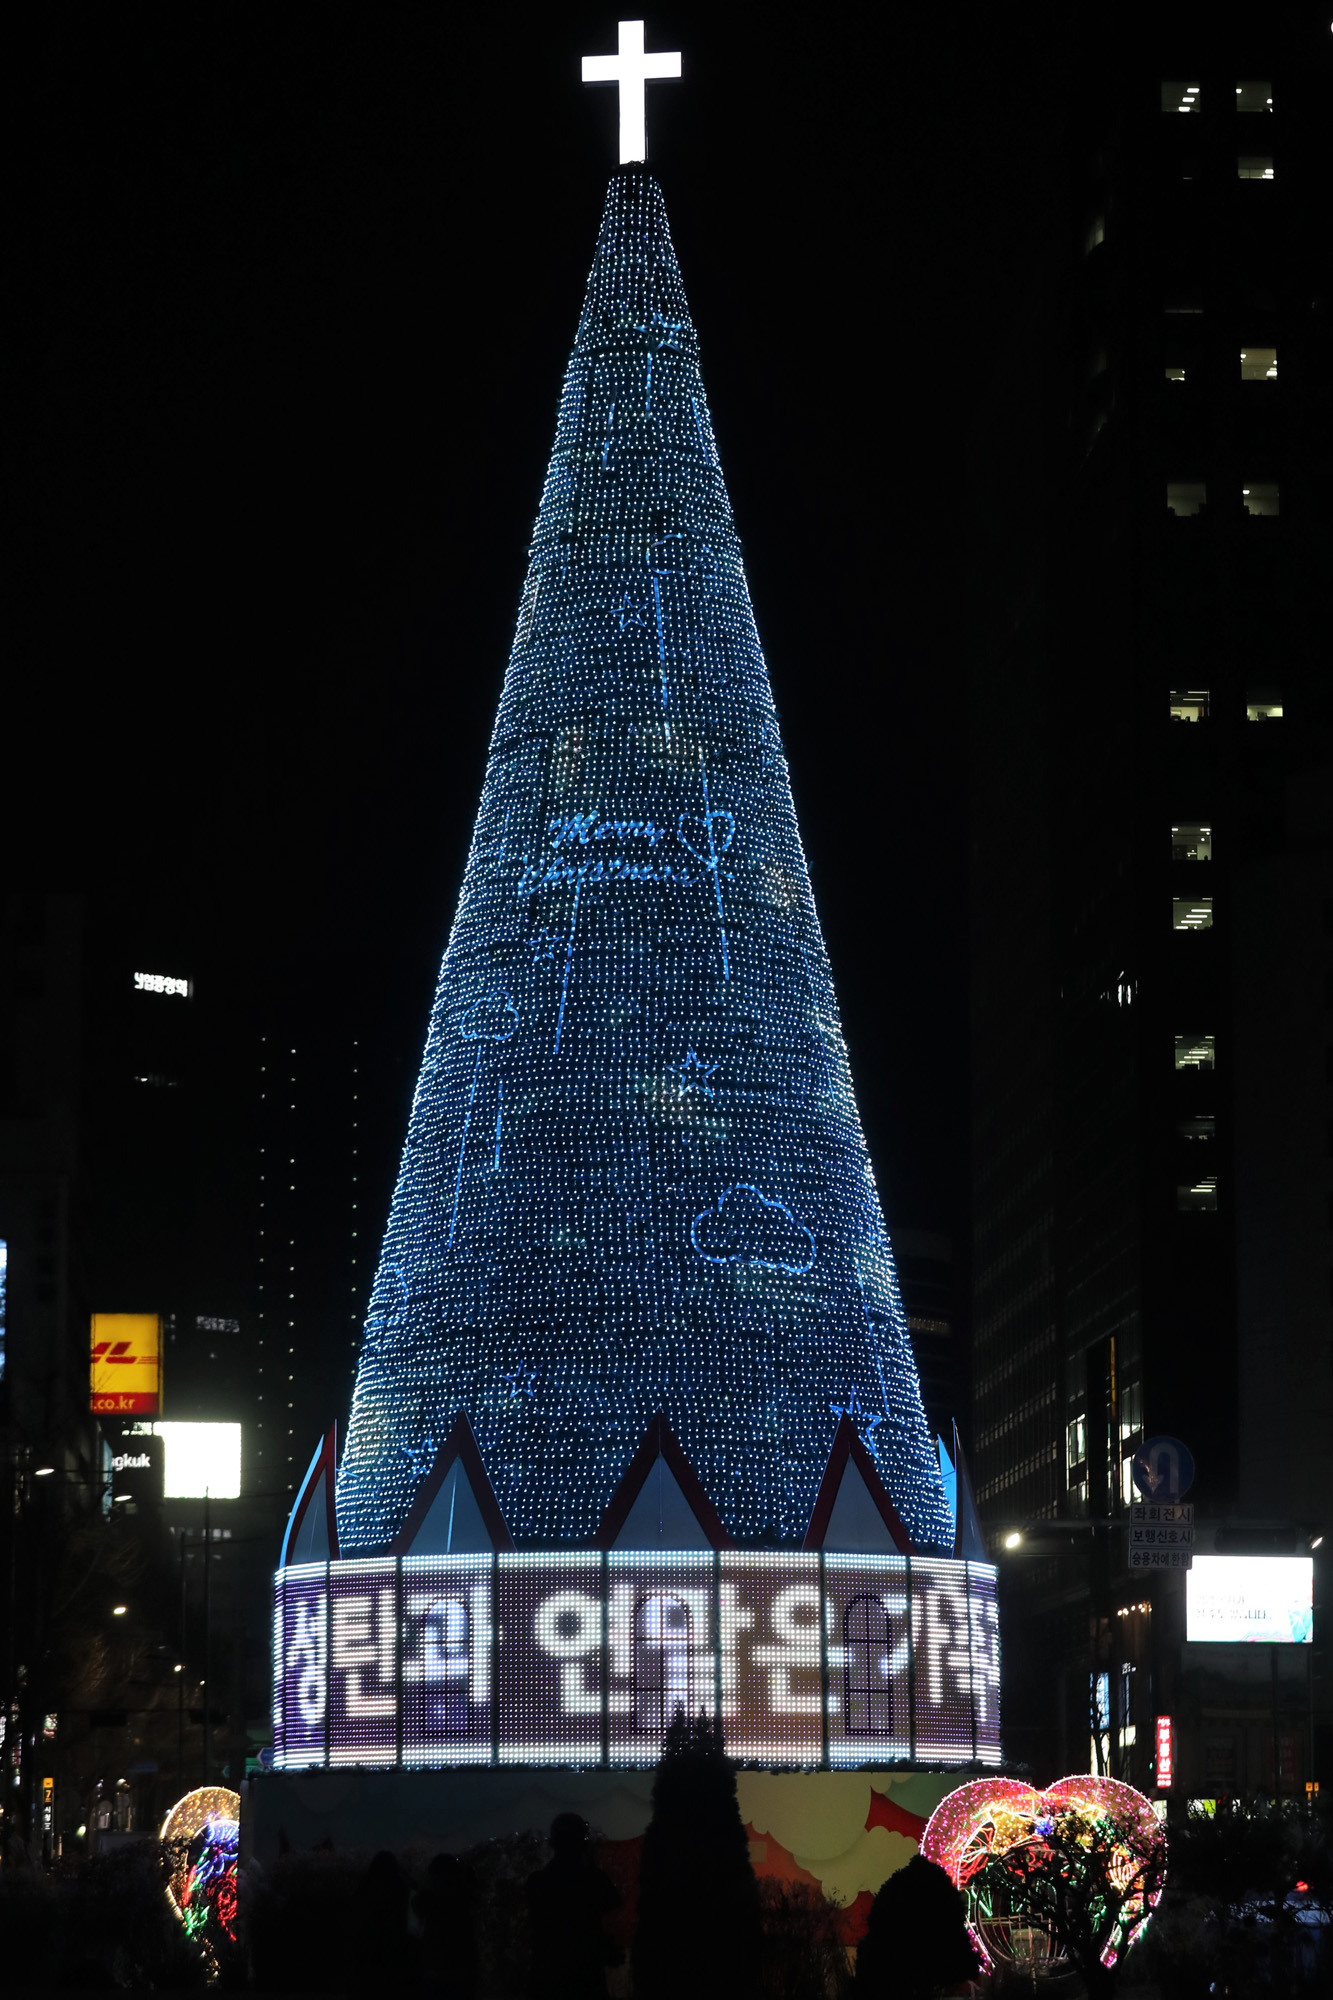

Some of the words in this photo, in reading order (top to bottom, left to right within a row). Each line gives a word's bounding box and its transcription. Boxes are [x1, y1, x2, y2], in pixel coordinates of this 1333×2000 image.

[548, 810, 666, 848] Merry
[286, 1584, 504, 1726] 성탄과
[534, 1582, 854, 1719] 연말은
